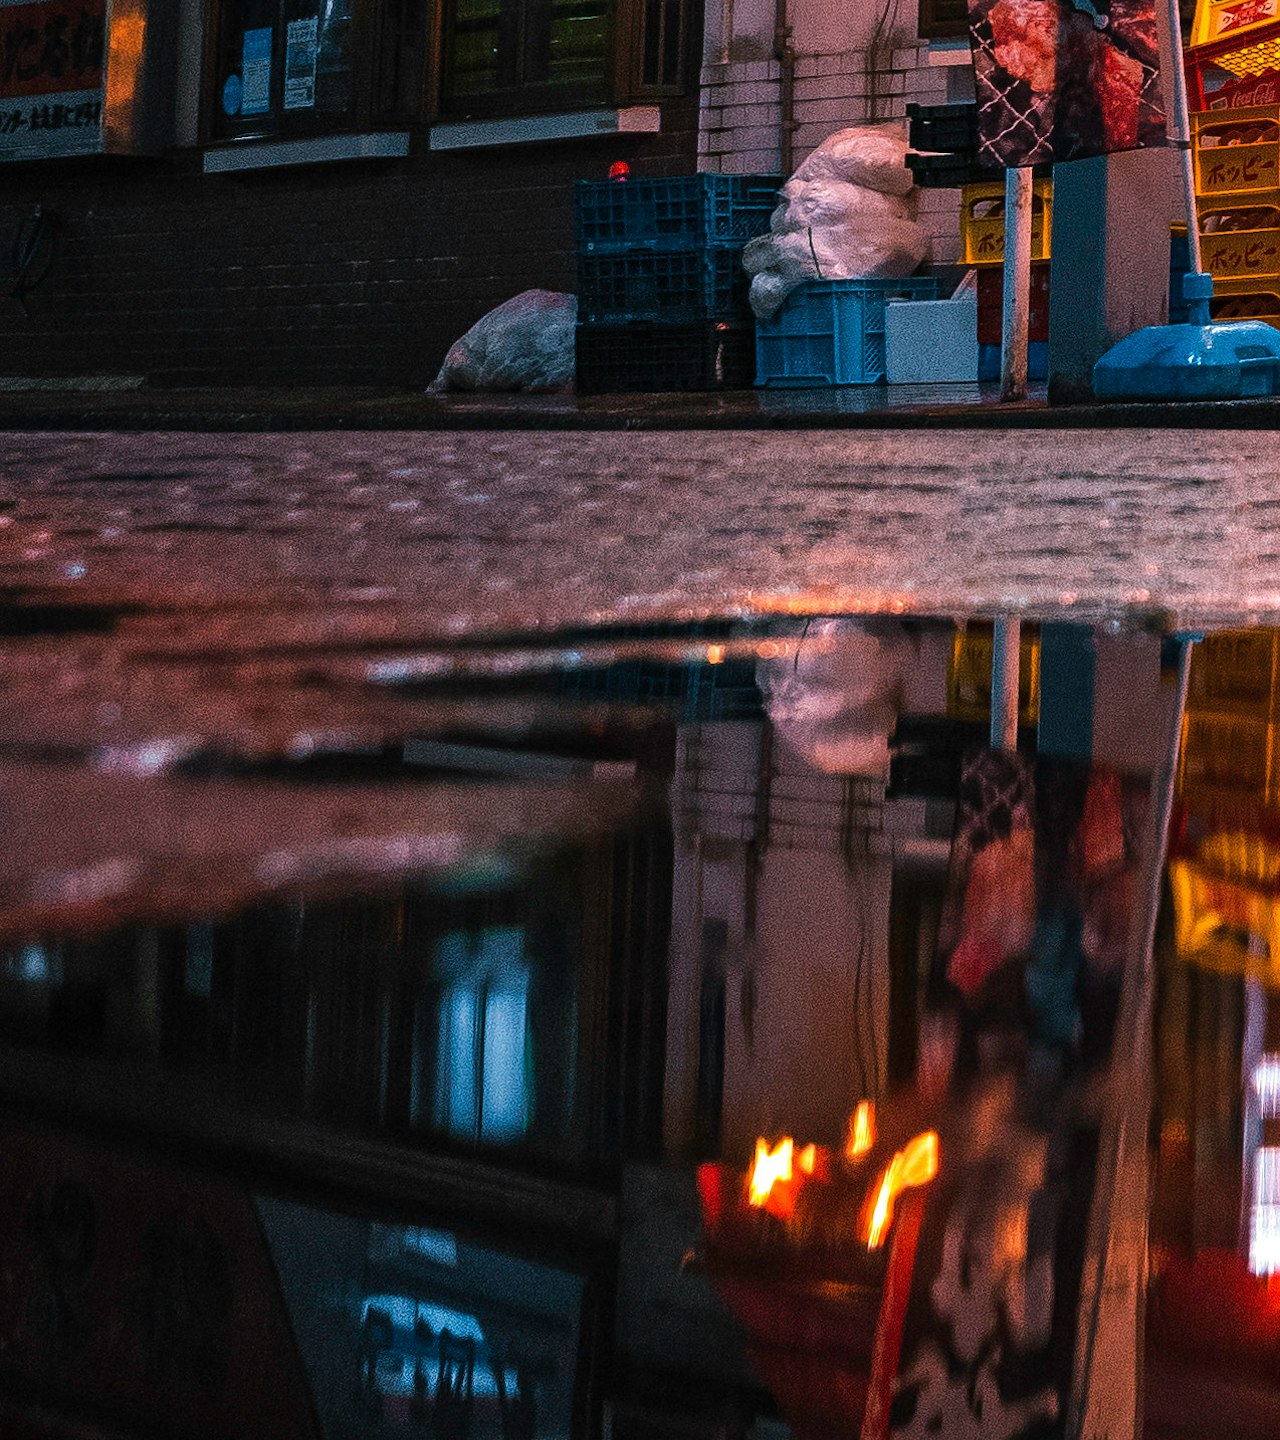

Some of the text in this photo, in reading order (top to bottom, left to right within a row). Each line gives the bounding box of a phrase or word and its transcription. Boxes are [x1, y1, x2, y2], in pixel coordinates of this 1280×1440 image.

[1208, 154, 1276, 186] ホッピー
[1209, 240, 1278, 270] ホッピー
